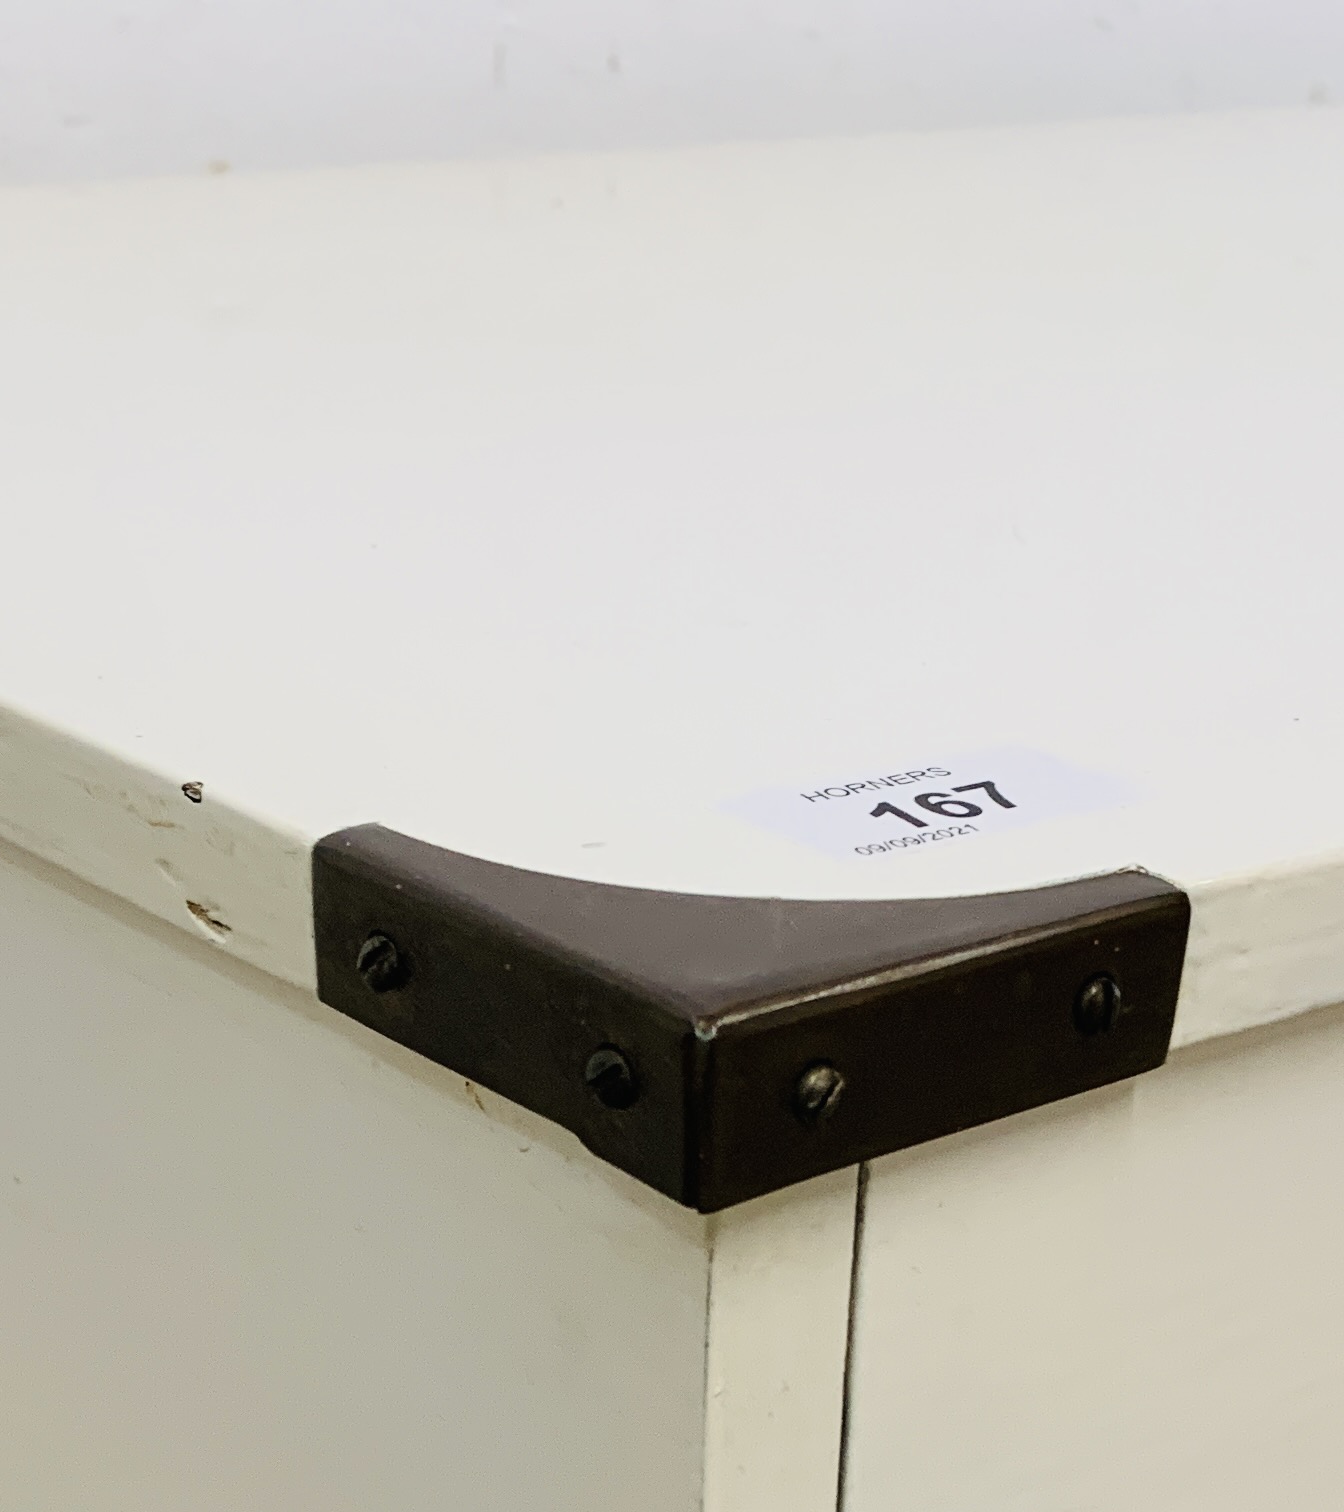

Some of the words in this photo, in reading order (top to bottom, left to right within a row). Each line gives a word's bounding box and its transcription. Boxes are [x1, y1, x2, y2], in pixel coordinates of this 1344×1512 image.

[800, 767, 952, 802] HORNERS
[869, 780, 1017, 828] 167
[854, 823, 979, 857] 09/09/2021
